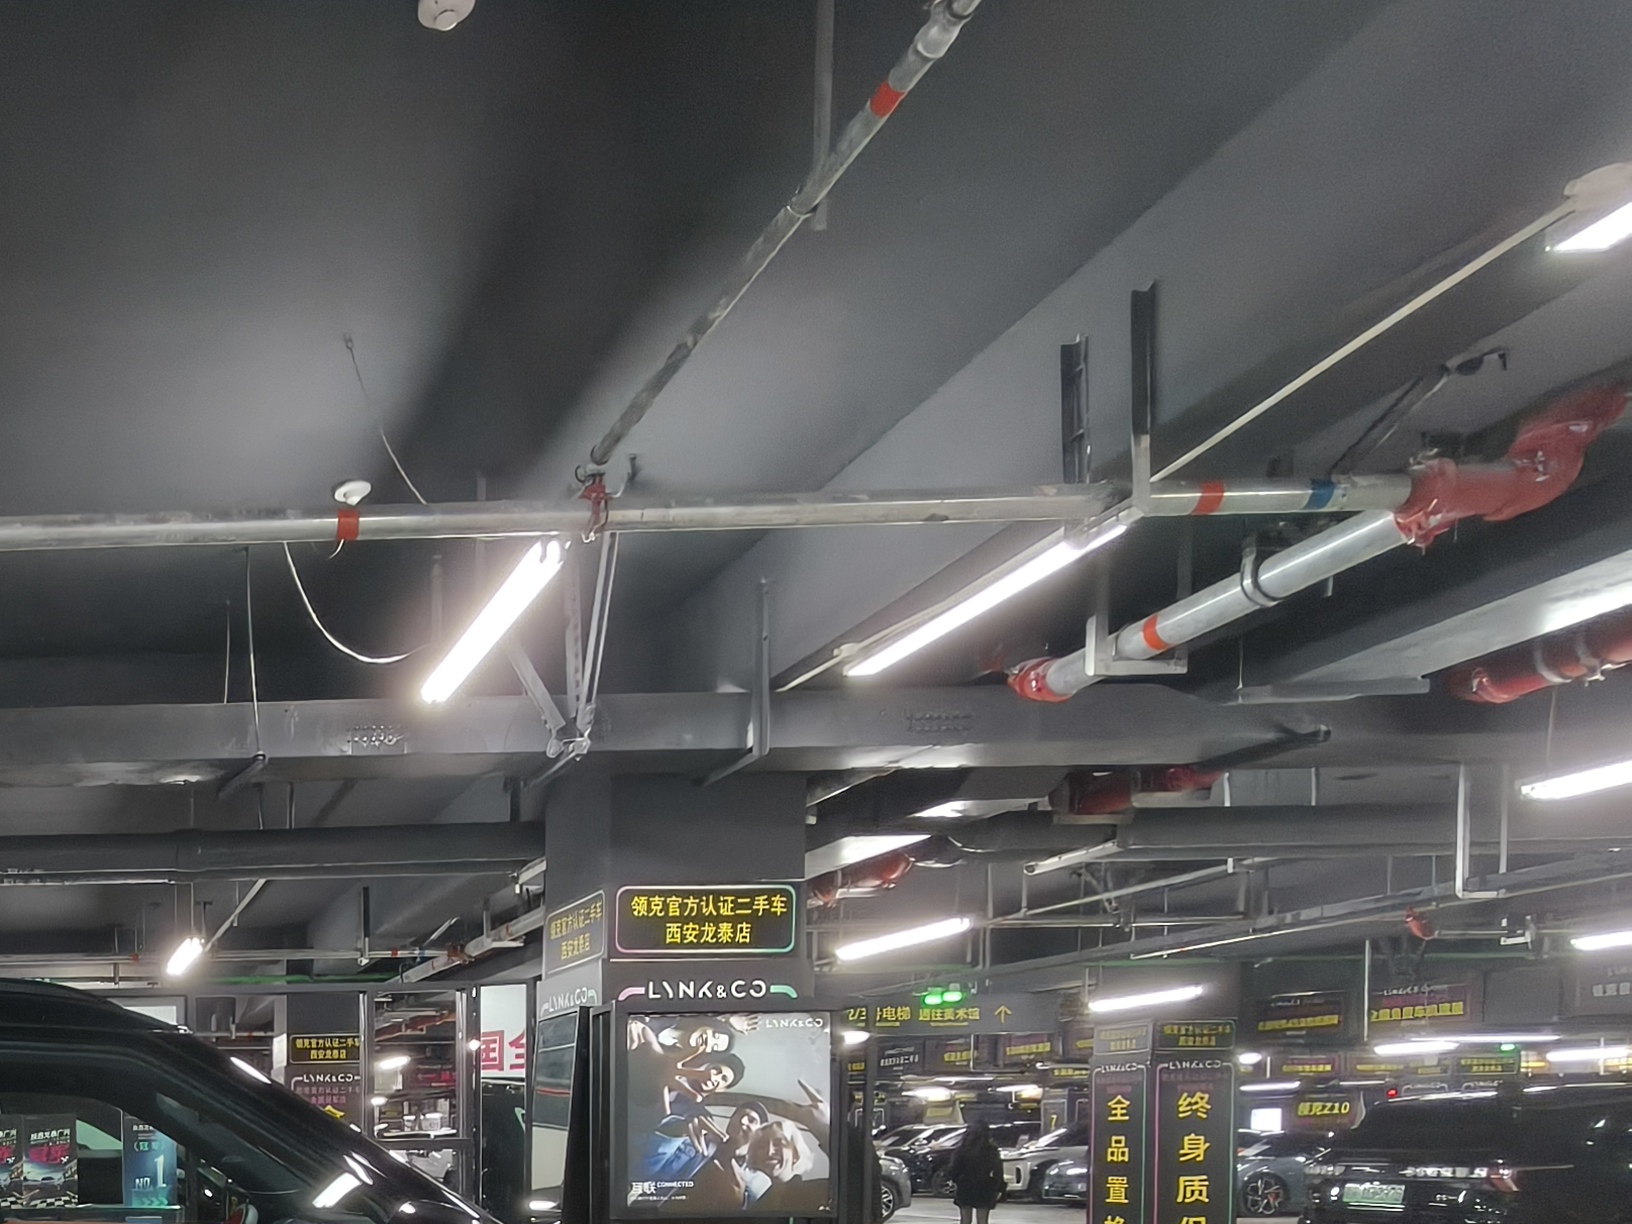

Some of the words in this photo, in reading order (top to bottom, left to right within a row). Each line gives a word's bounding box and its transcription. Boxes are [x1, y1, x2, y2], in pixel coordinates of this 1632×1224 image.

[631, 895, 788, 917] 领克官方认证二手车
[665, 922, 752, 944] 西安龙泰店
[648, 980, 767, 999] LYNK&CO
[765, 1018, 823, 1028] LYNK&CO
[303, 1073, 353, 1083] LYNK&CO
